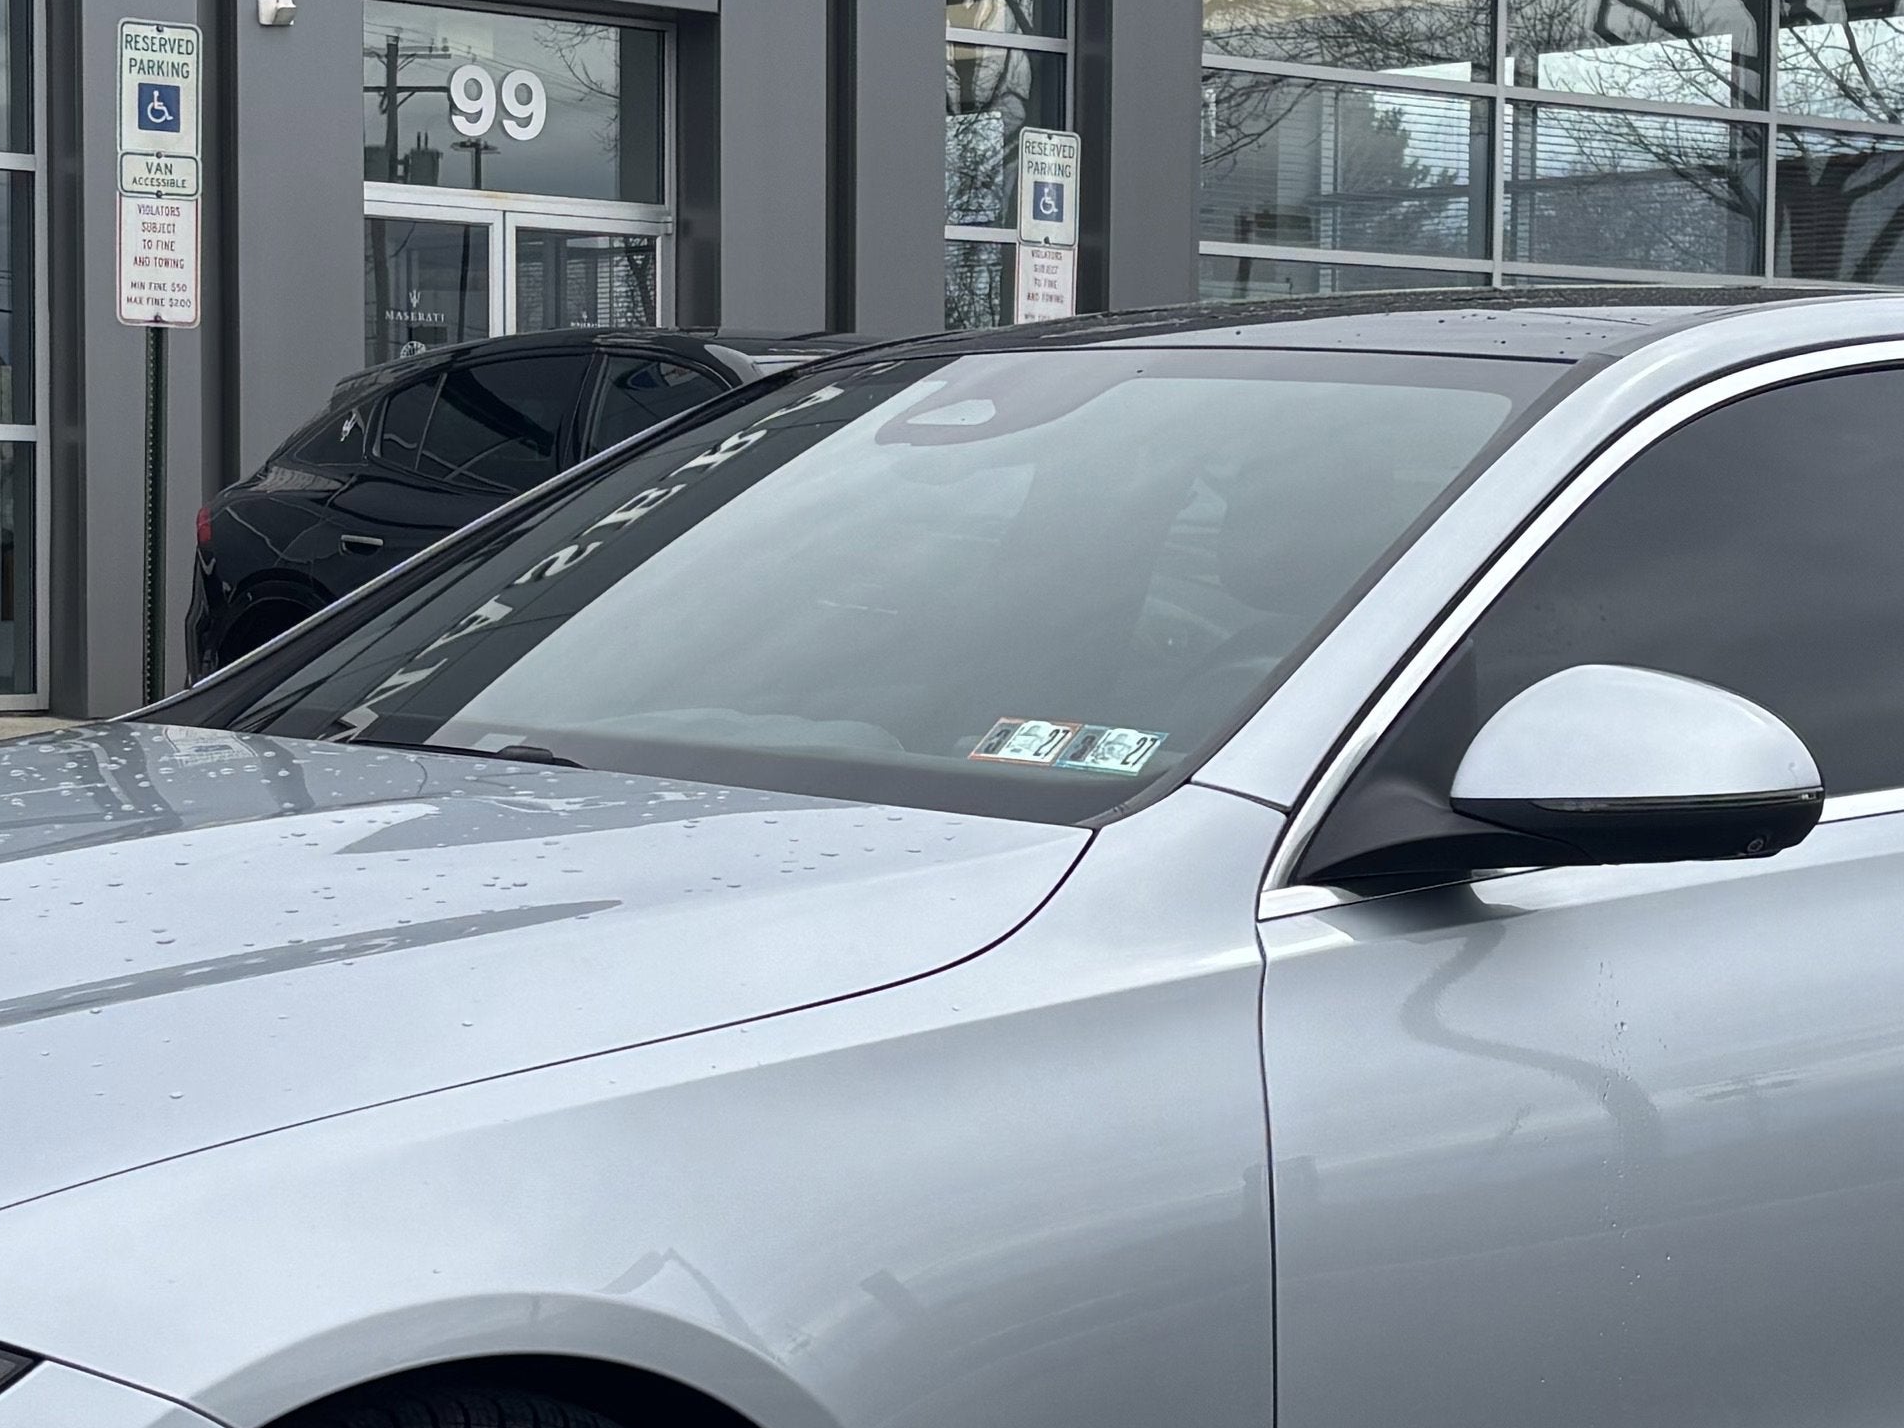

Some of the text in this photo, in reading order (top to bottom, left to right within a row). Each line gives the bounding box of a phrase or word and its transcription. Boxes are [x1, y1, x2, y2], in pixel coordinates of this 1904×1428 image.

[125, 33, 194, 56] RESERVED
[128, 58, 190, 79] PARKING
[449, 63, 547, 141] 99
[1024, 140, 1075, 159] RESERVED
[145, 162, 173, 176] VAN
[1027, 161, 1072, 178] PARKING
[132, 177, 187, 188] ACCESSIBLE
[137, 203, 181, 217] VIOLATORS
[141, 222, 176, 234] SUBJECT
[142, 239, 176, 252] TO FINE
[133, 256, 185, 270] AND TOWING
[130, 281, 188, 293] MIN FINE $50
[169, 298, 192, 308] $200
[385, 310, 445, 324] MASERATI
[1032, 728, 1071, 759] 27
[1120, 736, 1158, 767] 27
